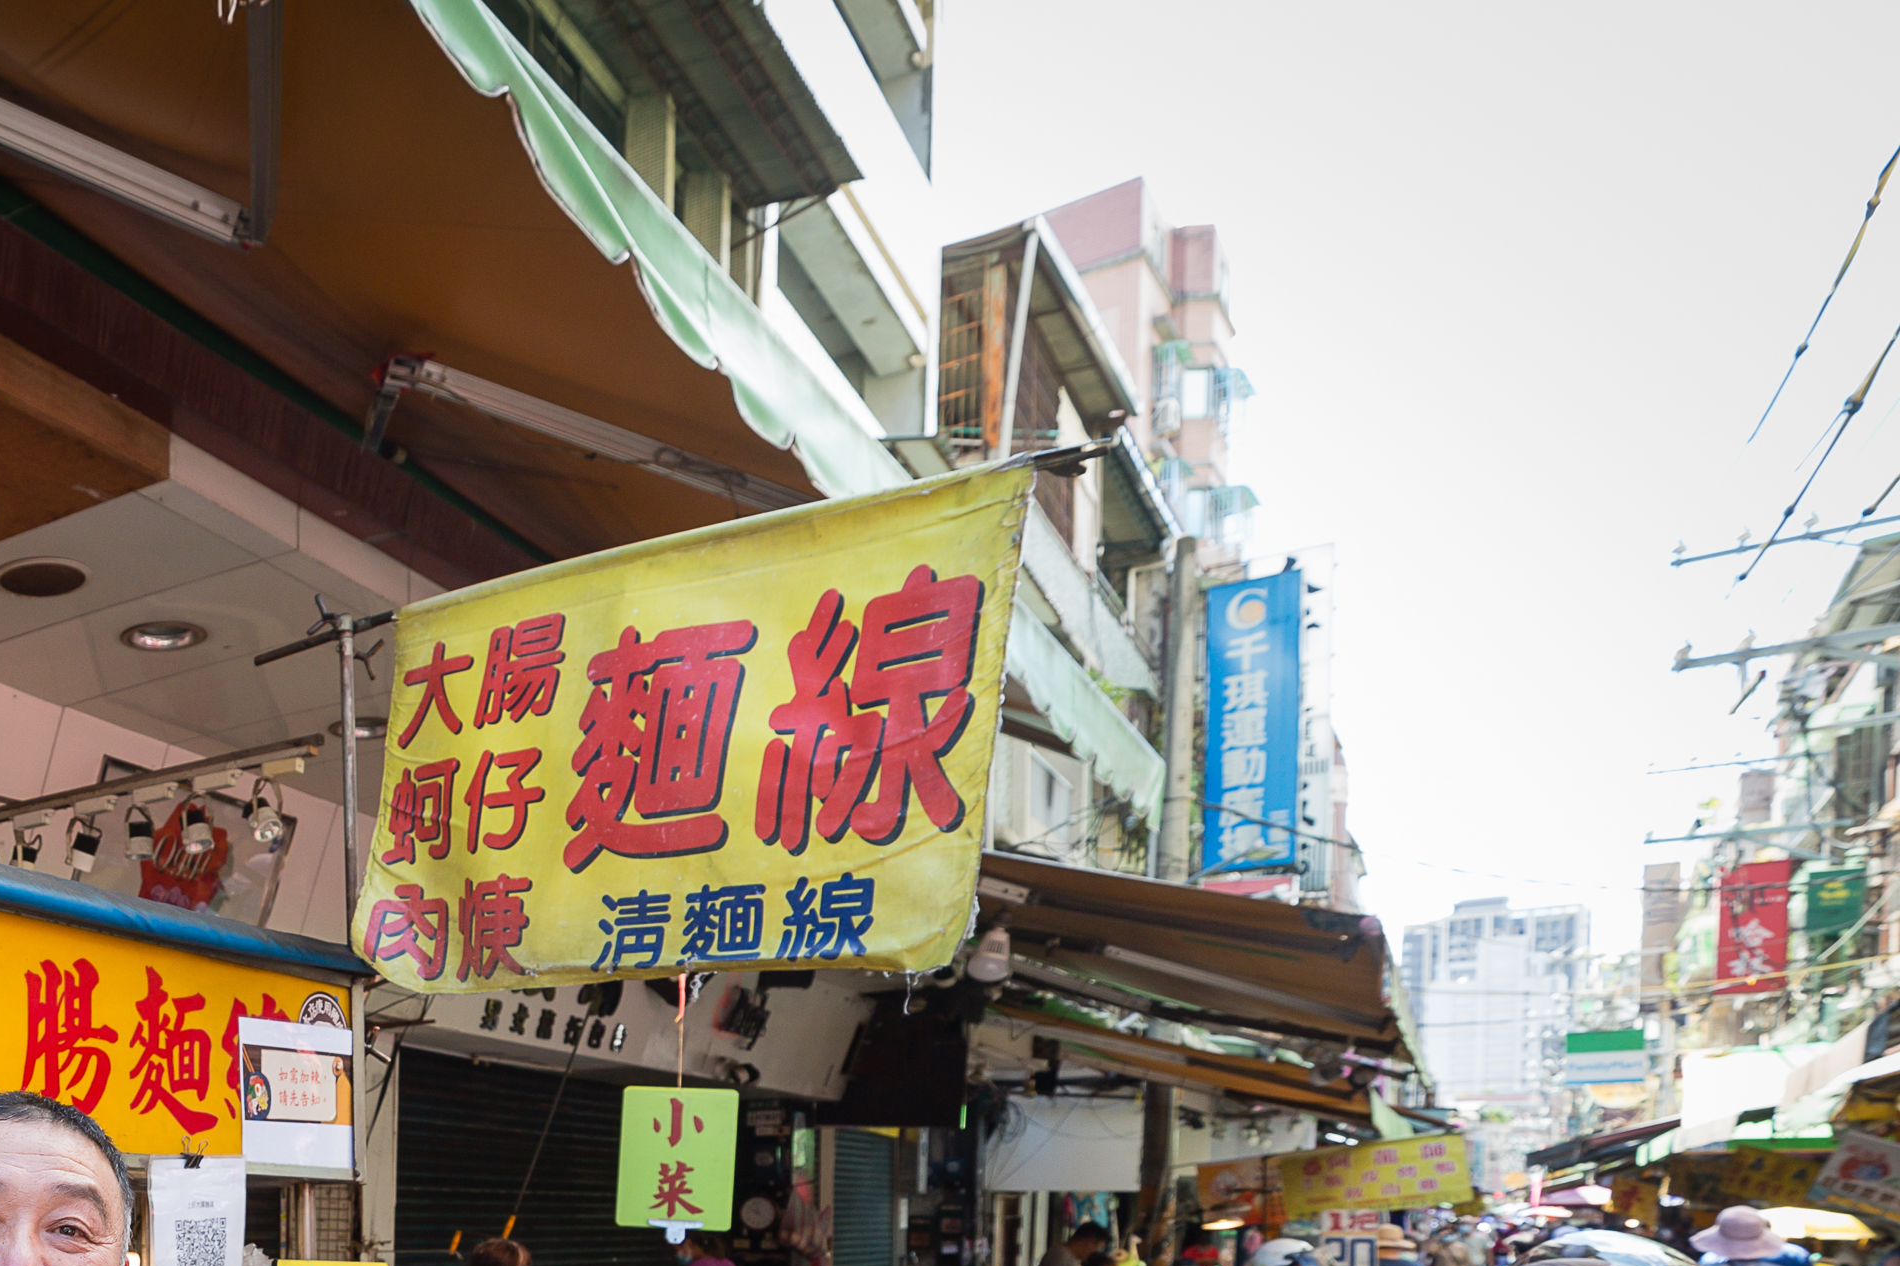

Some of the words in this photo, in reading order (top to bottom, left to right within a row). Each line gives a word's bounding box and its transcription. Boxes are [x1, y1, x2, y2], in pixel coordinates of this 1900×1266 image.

[399, 613, 566, 748] 大腸
[562, 564, 986, 874] 麵線
[381, 747, 545, 866] 蚵仔
[590, 871, 876, 972] 清麵線
[649, 1097, 704, 1218] 小菜
